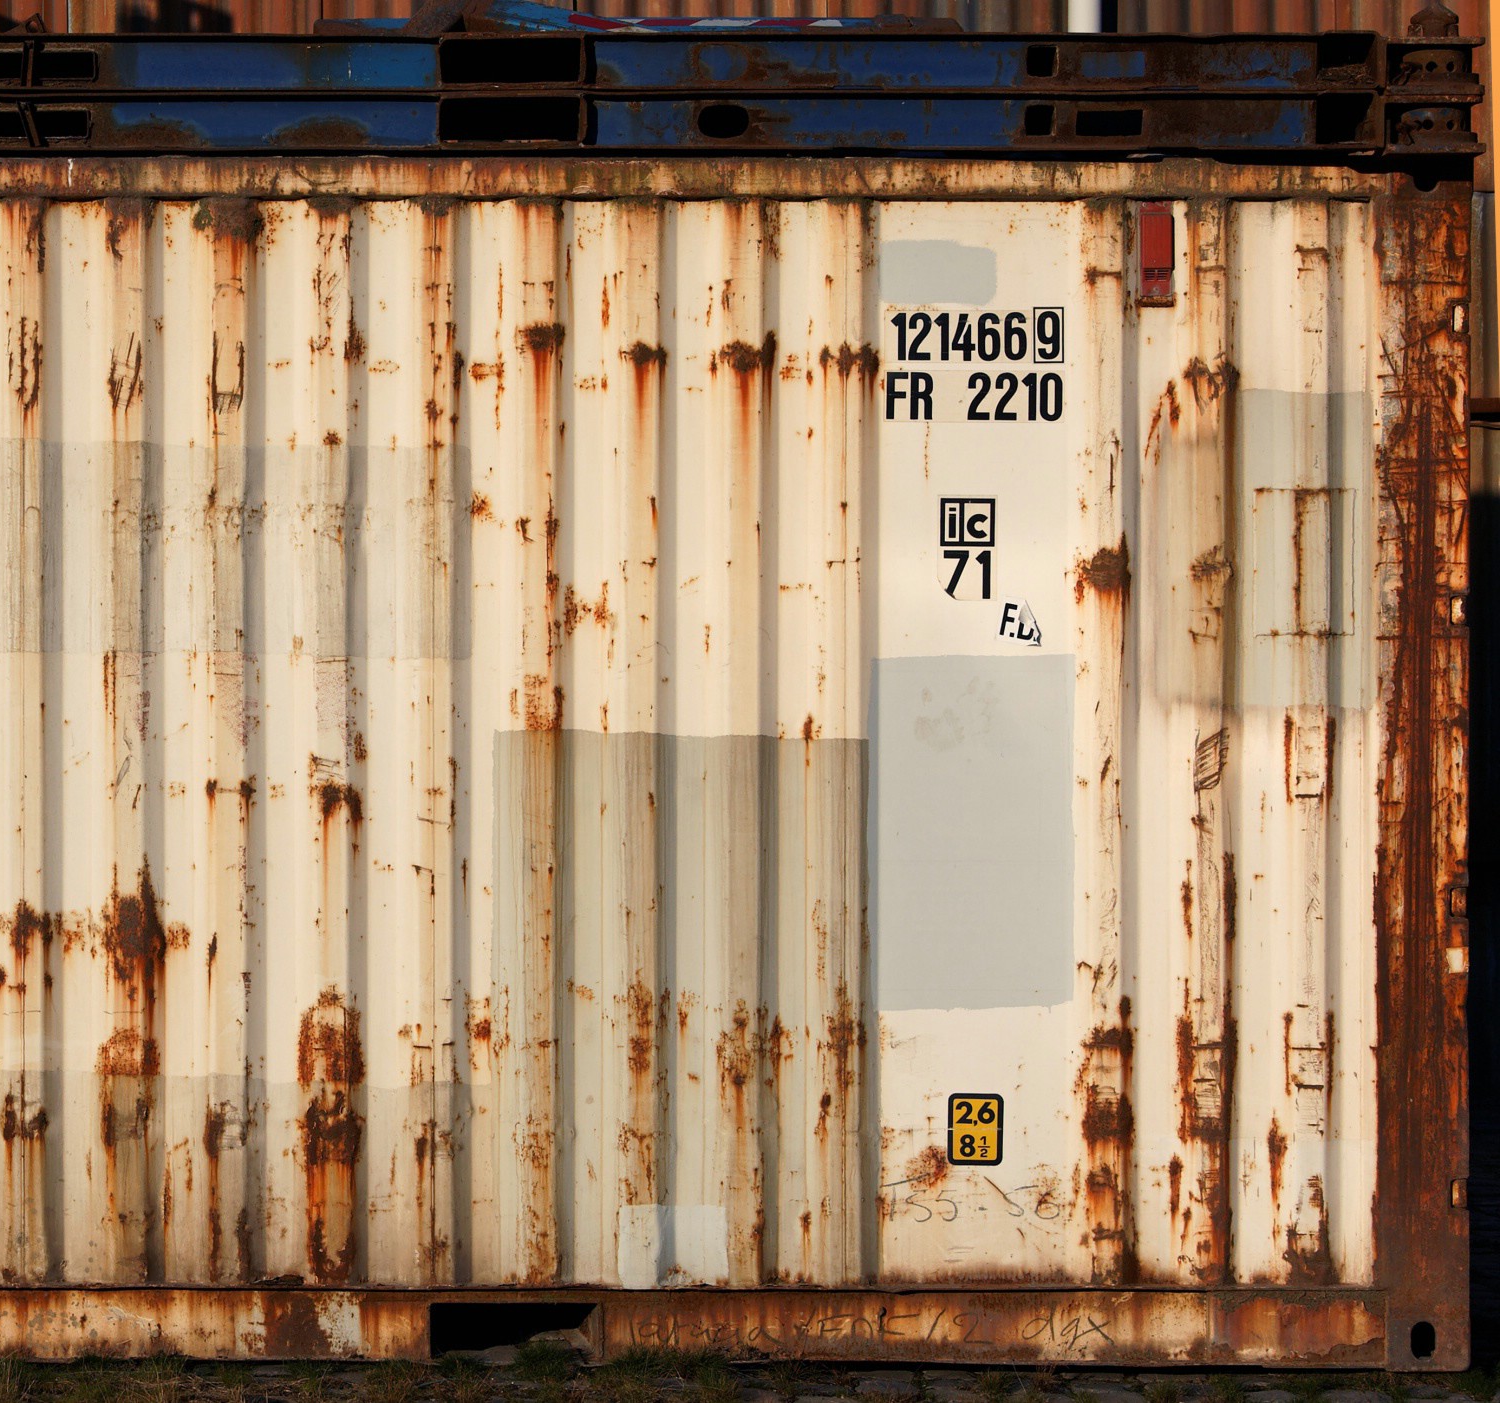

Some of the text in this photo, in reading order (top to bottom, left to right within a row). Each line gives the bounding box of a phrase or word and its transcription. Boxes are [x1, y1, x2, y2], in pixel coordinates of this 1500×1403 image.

[885, 371, 1064, 422] FR 2210
[942, 549, 992, 600] 71
[955, 1101, 996, 1126] 2,6
